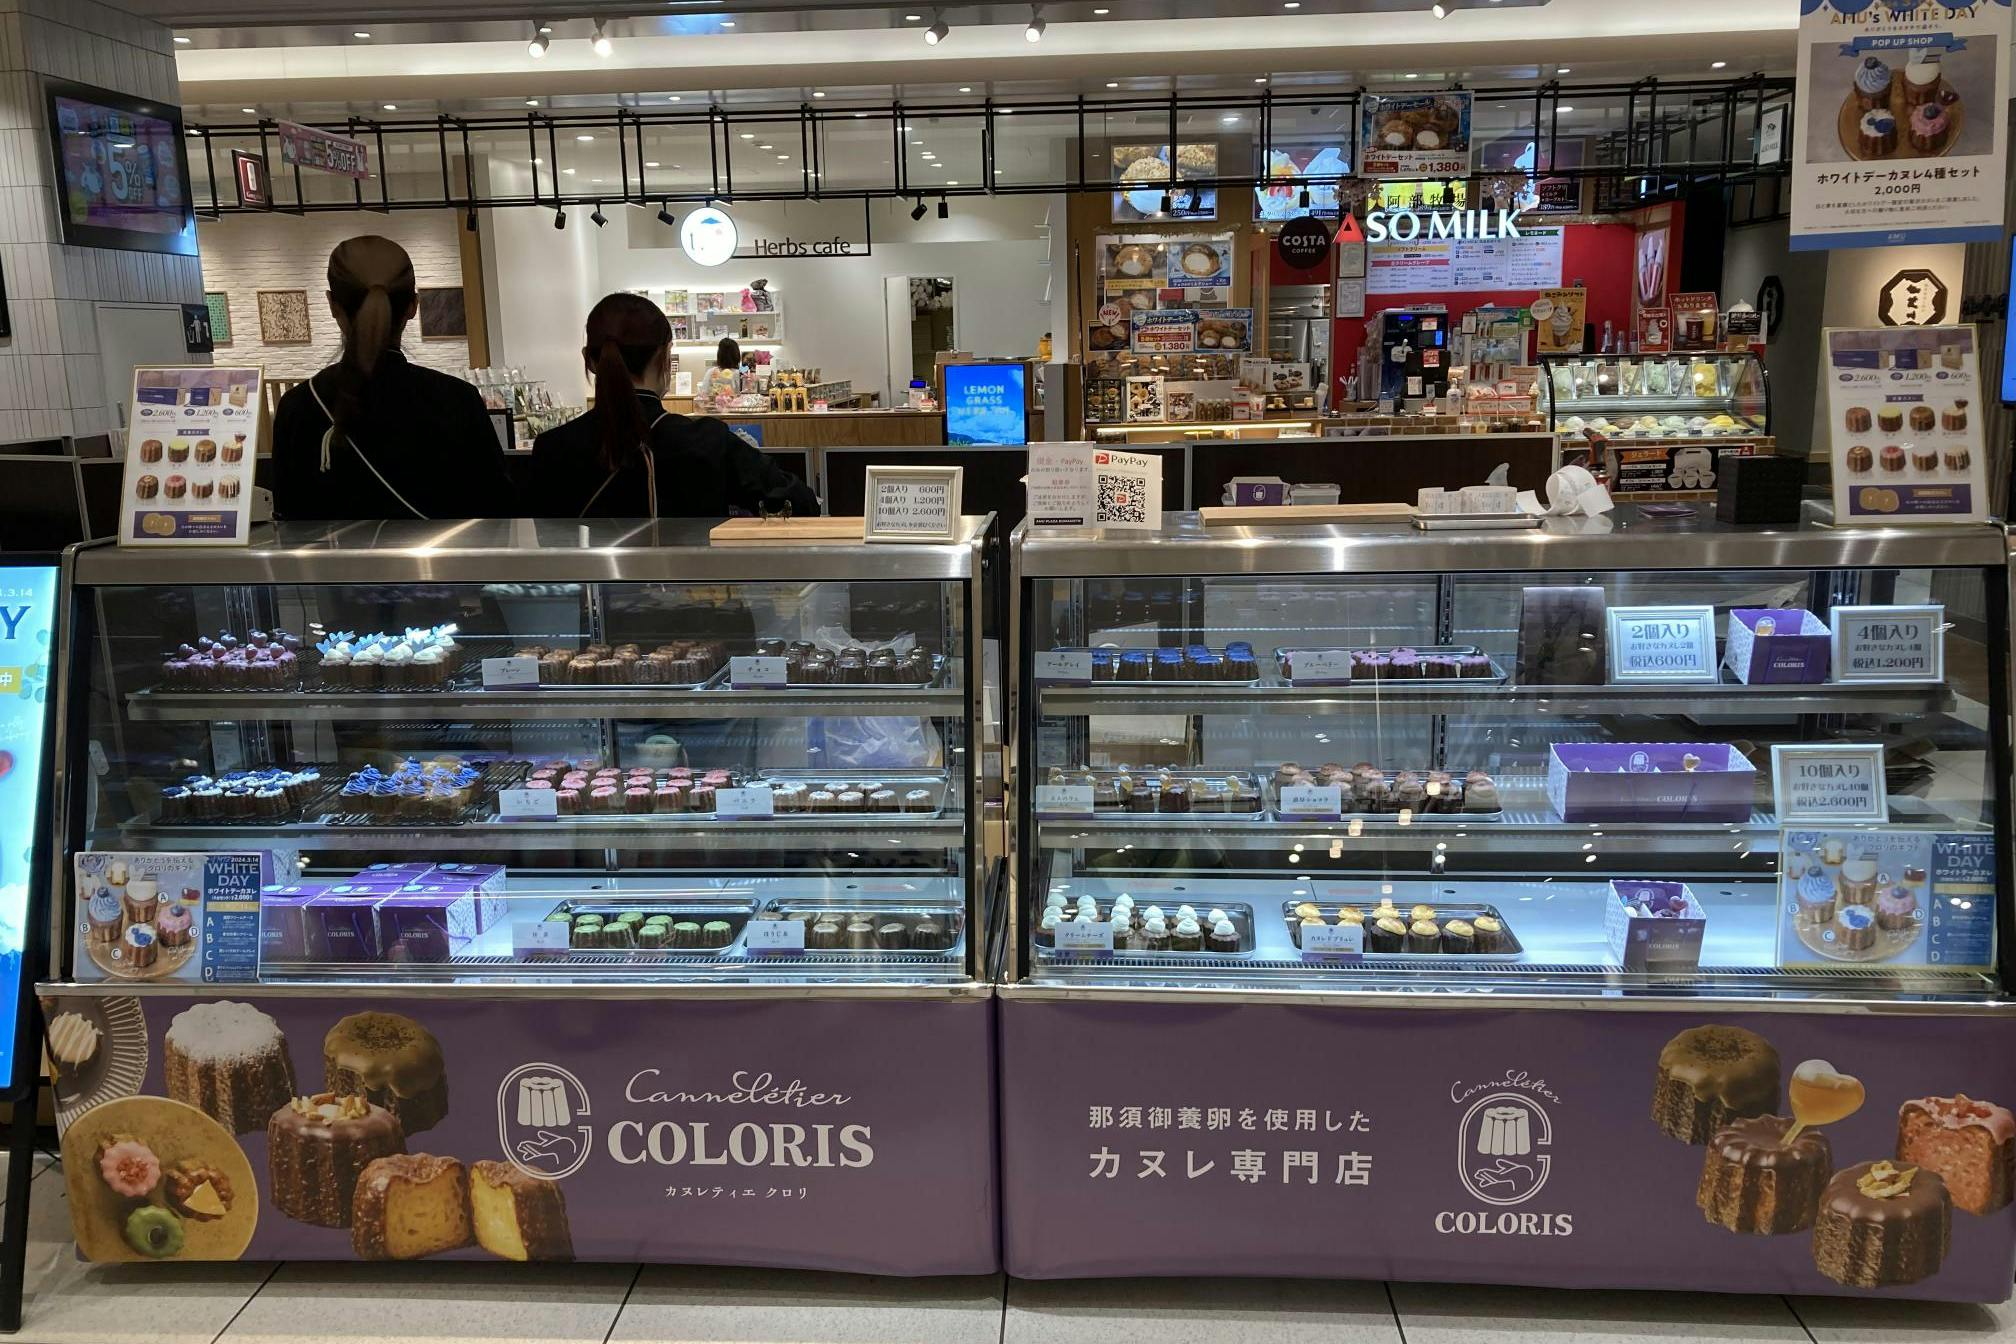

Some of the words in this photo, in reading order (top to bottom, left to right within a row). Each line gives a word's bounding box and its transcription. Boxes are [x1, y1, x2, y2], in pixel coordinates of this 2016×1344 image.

[1886, 8, 1940, 23] WHITE
[1944, 5, 1979, 20] DAY
[1872, 38, 1891, 47] POP
[1893, 38, 1906, 46] UP
[1907, 36, 1934, 45] SHOP
[1817, 165, 1981, 185] ホワイトデーカヌレ4種セット
[1874, 183, 1921, 195] 2,000円
[1427, 209, 1521, 241] MILK
[754, 237, 808, 255] Herbs
[812, 236, 850, 255] cafe
[1282, 235, 1326, 247] COSTA
[964, 384, 1005, 395] LEMON
[966, 395, 1003, 405] GRASS
[1111, 454, 1149, 467] PayPay
[881, 485, 908, 494] 2個入り
[919, 485, 945, 494] 600円
[878, 507, 909, 515] 10個入り
[1631, 623, 1689, 640] 2個入り
[1856, 624, 1919, 641] 4個入り
[1631, 641, 1694, 650] お好きなカヌレ2個
[1631, 654, 1697, 668] 税込600円
[1799, 764, 1860, 778] 10個入り
[1936, 843, 1995, 855] WHITE
[1947, 855, 1985, 868] DAY
[208, 863, 259, 874] WHITE
[218, 875, 250, 886] DAY
[1933, 898, 1943, 910] A
[206, 916, 214, 927] A
[1932, 916, 1941, 927] B
[206, 933, 214, 944] B
[1931, 934, 1941, 945] C
[205, 950, 213, 960] C
[1931, 951, 1940, 961] D
[204, 966, 213, 977] D
[624, 1068, 852, 1108] Cannelétier
[1088, 1104, 1371, 1132] 那須御養卵を使用した
[607, 1119, 875, 1168] COLORIS
[1088, 1146, 1374, 1187] カヌレ専門店
[664, 1185, 756, 1199] カヌレティエ
[766, 1186, 808, 1200] クロリ
[1434, 1211, 1574, 1236] COLORIS
